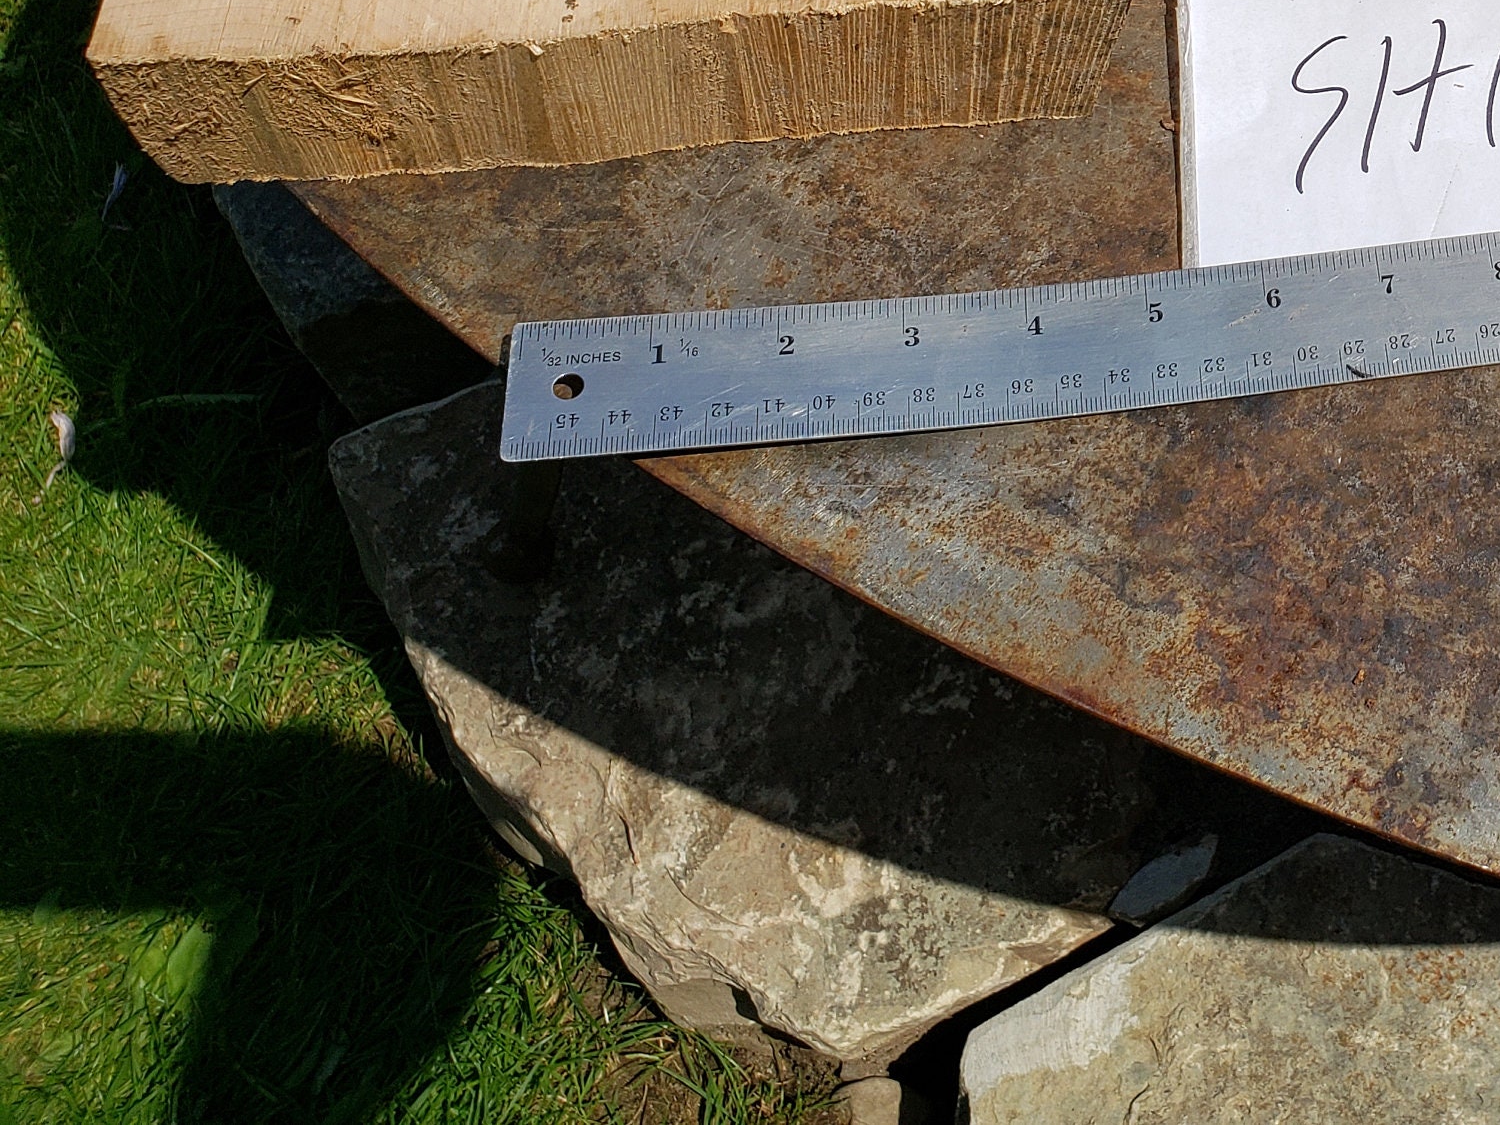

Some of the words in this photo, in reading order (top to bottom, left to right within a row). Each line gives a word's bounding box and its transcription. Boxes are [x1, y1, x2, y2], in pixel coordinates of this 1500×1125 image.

[651, 344, 667, 365] 1
[779, 335, 795, 355] 2
[904, 327, 920, 347] 3
[1027, 316, 1043, 335] 4
[1149, 302, 1163, 323] 5
[1266, 288, 1281, 308] 6
[1381, 274, 1394, 294] 7
[1435, 328, 1456, 344] 27
[1479, 323, 1500, 338] 26
[1343, 340, 1365, 355] 29
[1389, 334, 1411, 350] 28
[566, 351, 622, 365] INCHES
[1251, 351, 1272, 367] 31
[1297, 345, 1318, 361] 30
[1157, 362, 1178, 378] 33
[1203, 357, 1225, 373] 32
[1060, 374, 1082, 389] 35
[1108, 368, 1130, 383] 34
[963, 383, 985, 398] 37
[1011, 379, 1034, 394] 36
[863, 391, 886, 406] 39
[913, 387, 935, 402] 38
[711, 402, 735, 417] 42
[763, 398, 785, 413] 41
[813, 395, 836, 410] 40
[556, 413, 580, 428] 45
[608, 410, 632, 424] 44
[660, 406, 684, 421] 43
